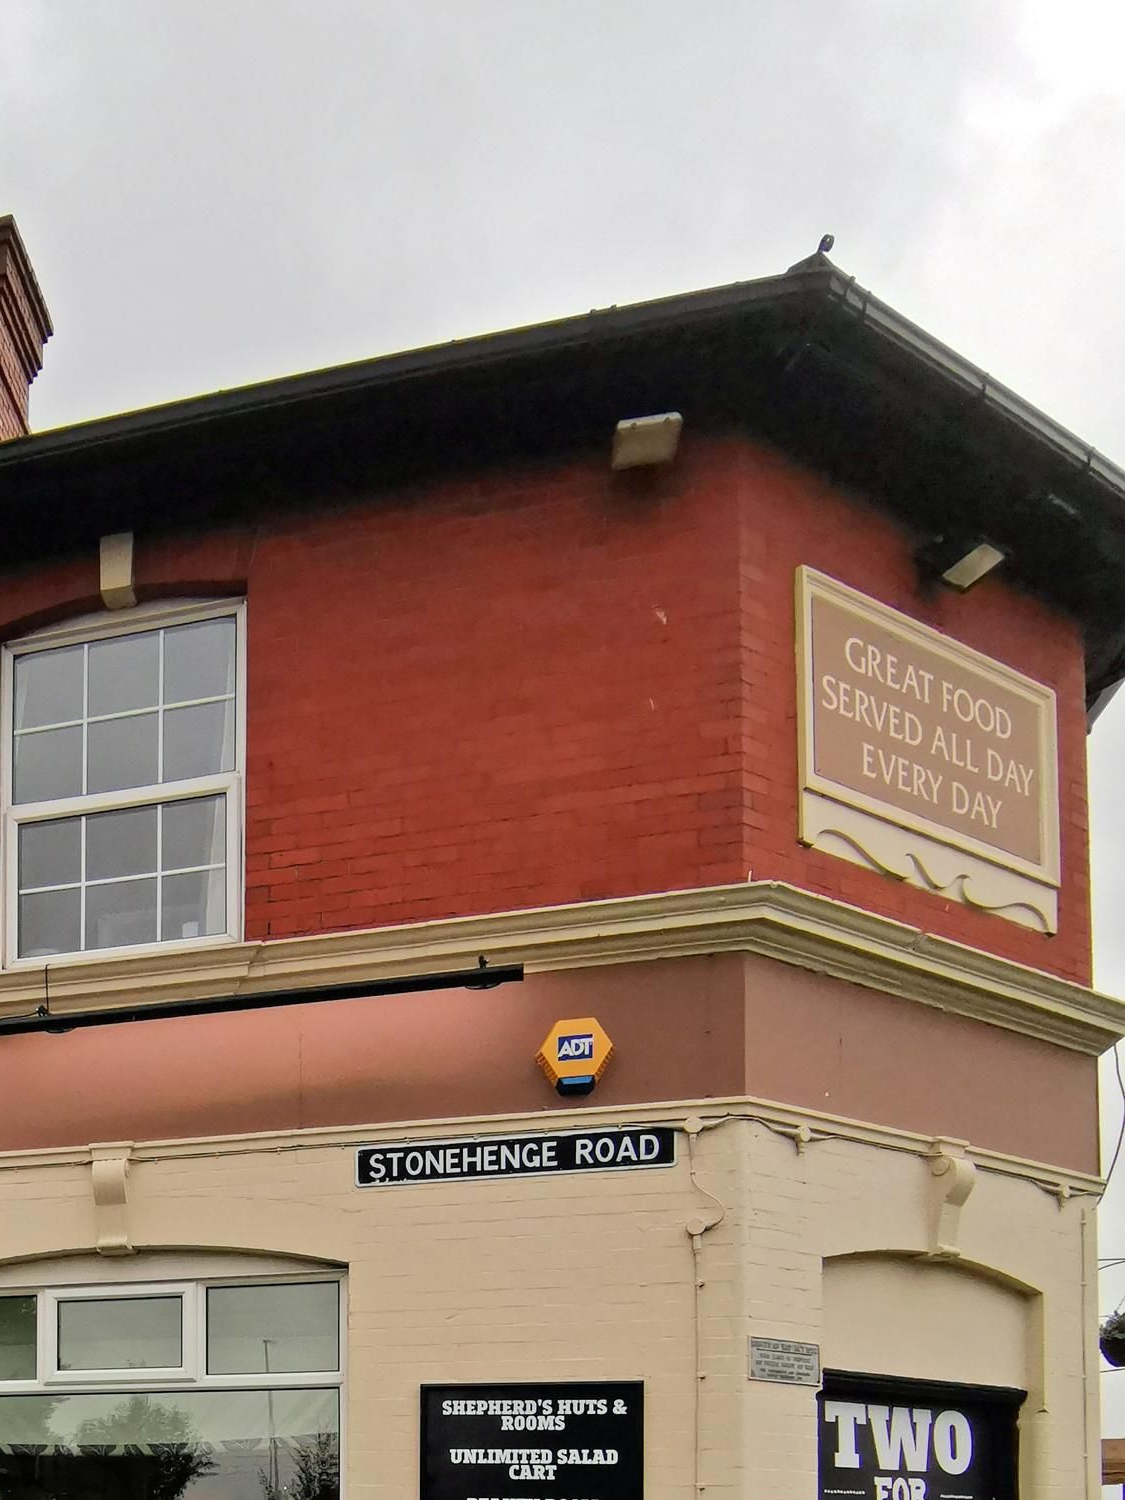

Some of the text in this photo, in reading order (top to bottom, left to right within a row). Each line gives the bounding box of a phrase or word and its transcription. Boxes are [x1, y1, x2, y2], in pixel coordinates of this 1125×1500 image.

[844, 637, 1011, 739] GREAT FOOD
[821, 675, 1035, 796] SERVED ALL DAY
[862, 742, 1002, 829] EVERY DAY
[557, 1037, 594, 1058] ADT
[368, 1133, 660, 1179] STONEHENGE ROAD
[442, 1399, 628, 1416] SHEPHERD'S HUTS &
[501, 1415, 566, 1431] ROOMS
[824, 1400, 973, 1476] TWO
[449, 1449, 619, 1465] UNLIMITED SALAD
[508, 1465, 557, 1480] CART
